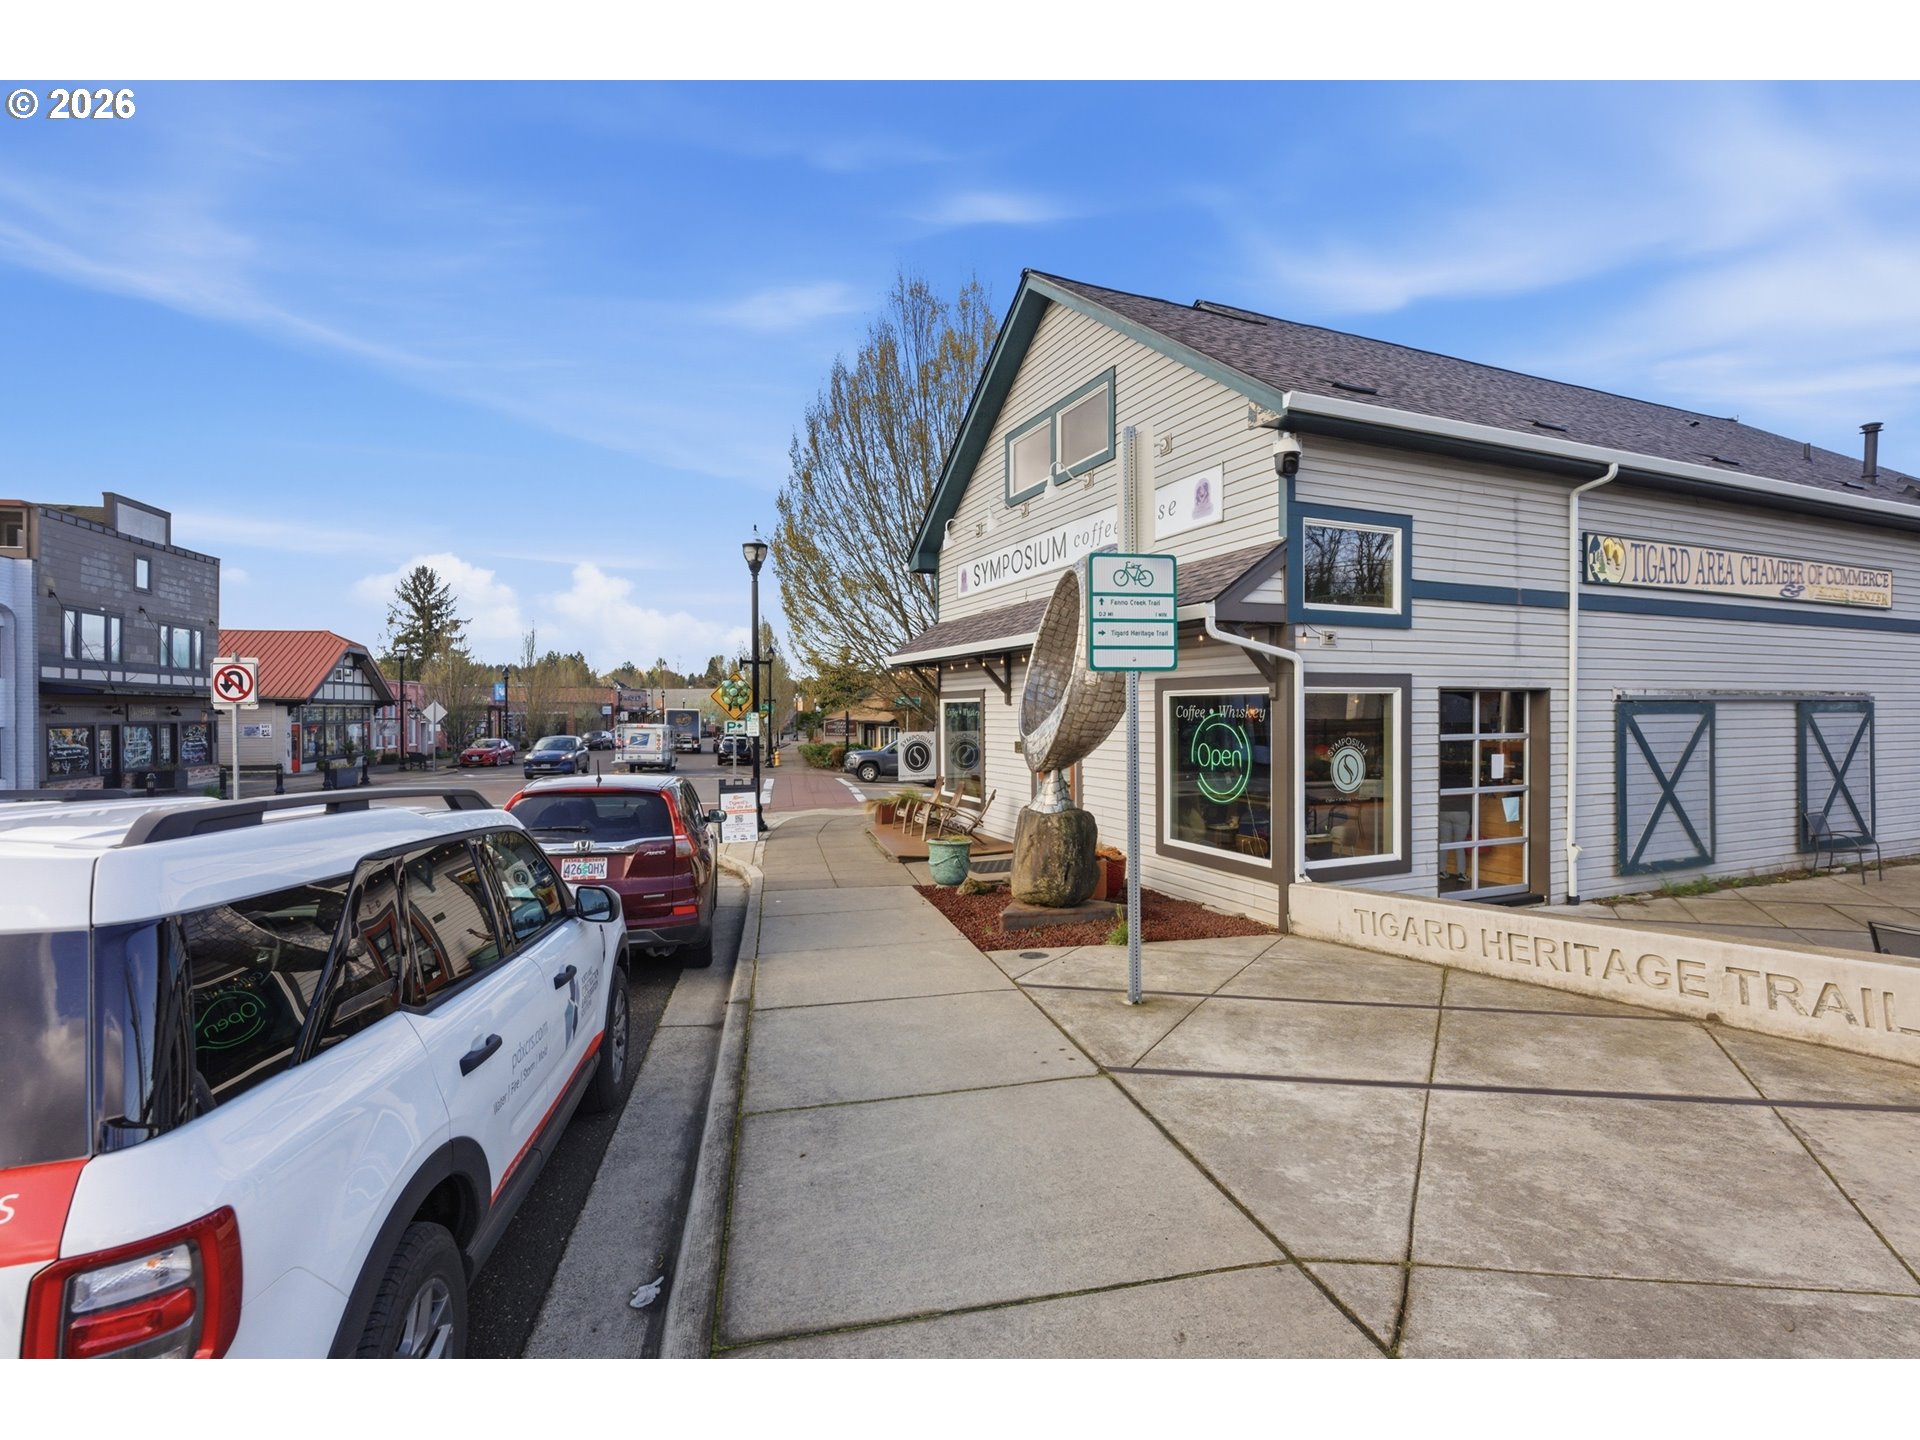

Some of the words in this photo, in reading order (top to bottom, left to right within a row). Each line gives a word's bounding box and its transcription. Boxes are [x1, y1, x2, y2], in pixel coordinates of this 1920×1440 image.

[973, 531, 1067, 587] SYMPOSIUM
[1630, 542, 1691, 585] TIGARD
[1694, 550, 1735, 586] AREA
[1740, 555, 1805, 586] CHAMBER
[1808, 563, 1823, 586] OF
[1826, 566, 1889, 588] COMMERCE
[1111, 629, 1129, 637] Tigard
[1130, 630, 1154, 638] Heritage
[1156, 629, 1169, 637] Trail
[1175, 704, 1206, 721] Coffee
[1219, 704, 1266, 722] Whiskey
[727, 721, 736, 733] P
[900, 734, 934, 748] SYMPOSIUM
[1328, 736, 1368, 756] SYMPOSIUM
[1197, 742, 1242, 771] Open
[1353, 907, 1468, 951] TIGARD
[1480, 927, 1710, 999] HERITAGE
[1724, 965, 1920, 1037] TRAIL
